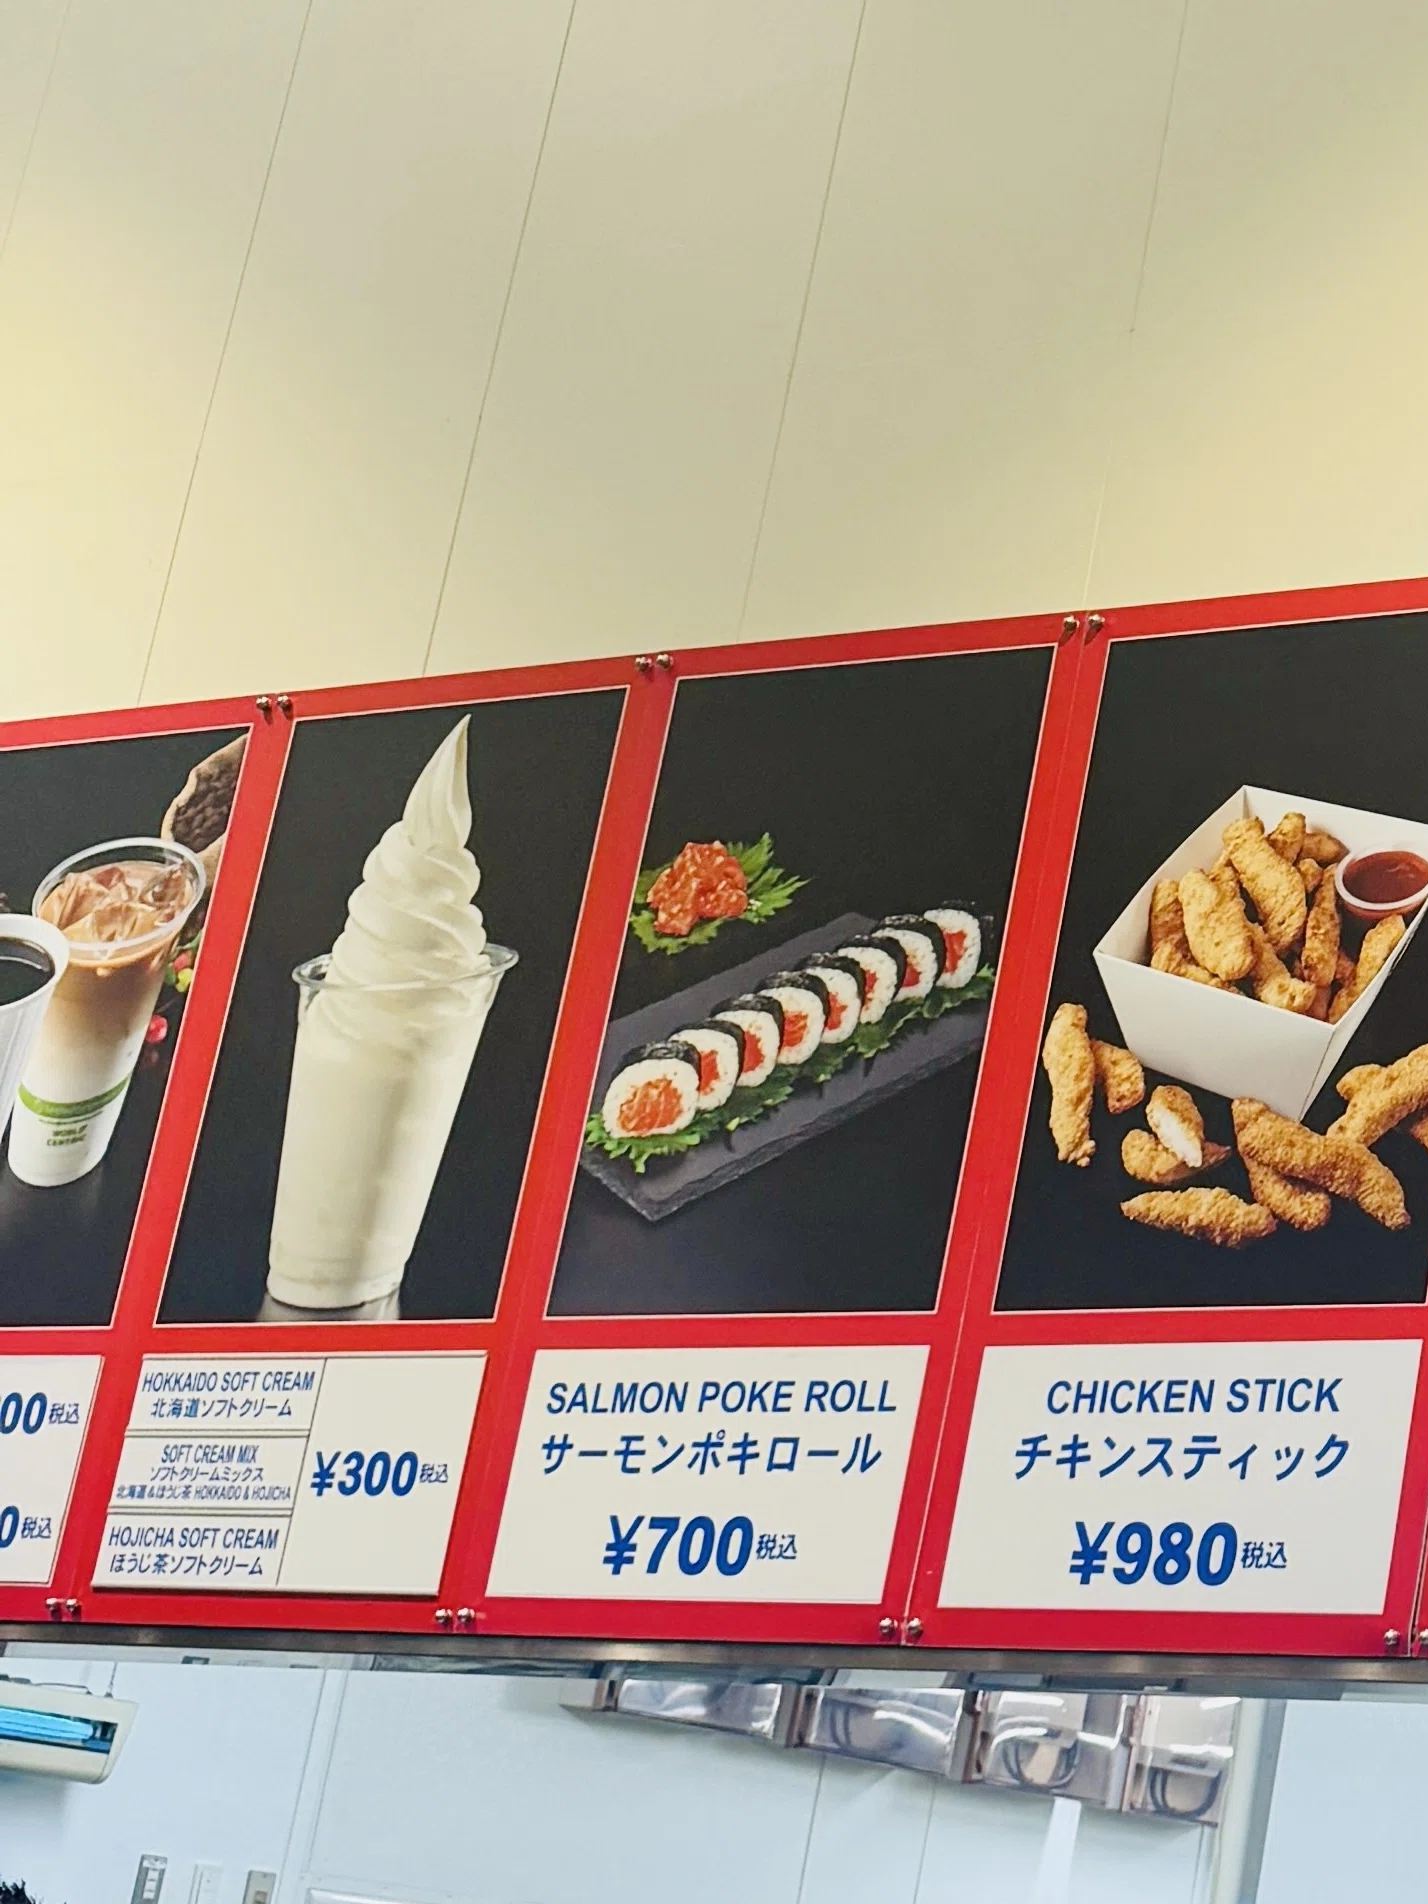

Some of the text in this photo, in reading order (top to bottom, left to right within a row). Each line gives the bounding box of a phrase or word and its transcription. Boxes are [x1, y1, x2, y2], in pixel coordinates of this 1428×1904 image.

[142, 1371, 315, 1393] HOKKAIDO SOFT CREAM
[547, 1380, 896, 1414] SALMON POKE ROLL
[1048, 1378, 1342, 1414] CHICKEN STICK
[49, 1403, 80, 1425] 税込
[150, 1397, 293, 1419] 北海道ソフトクリーム
[161, 1444, 260, 1464] SOFT CREAM MIX
[542, 1430, 881, 1475] サーモンポキロール
[1016, 1434, 1348, 1480] チキンスティック
[149, 1466, 264, 1482] ソフトクリームミックス
[311, 1451, 449, 1496] ¥300 税込
[193, 1484, 242, 1500] HOKKAIDO
[242, 1485, 249, 1500] &
[250, 1484, 292, 1501] HOJICHA
[20, 1516, 52, 1539] 税込
[109, 1527, 279, 1549] HOJICHA SOFT CREAM
[603, 1516, 797, 1576] ¥700 税込
[1070, 1522, 1288, 1586] ¥980 税込
[110, 1553, 263, 1576] ほうじ茶ソフトクリーム
